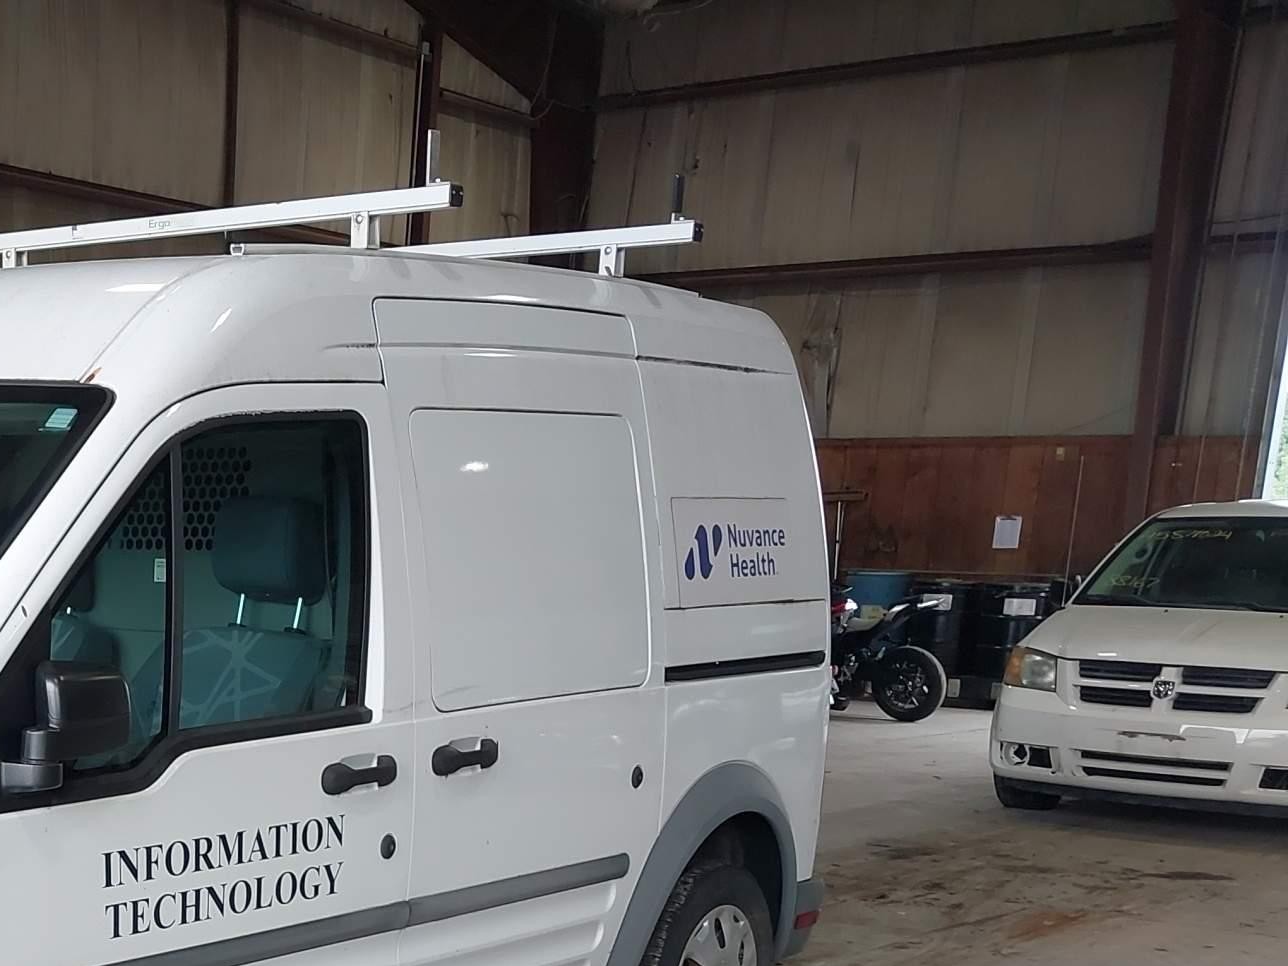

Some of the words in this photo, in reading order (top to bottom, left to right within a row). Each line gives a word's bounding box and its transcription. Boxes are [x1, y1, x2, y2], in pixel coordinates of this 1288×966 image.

[148, 219, 171, 230] Ergo
[727, 523, 785, 548] Nuvance
[730, 551, 776, 578] Health
[102, 814, 345, 889] INFORMATION
[105, 861, 344, 940] TECHNOLOGY
